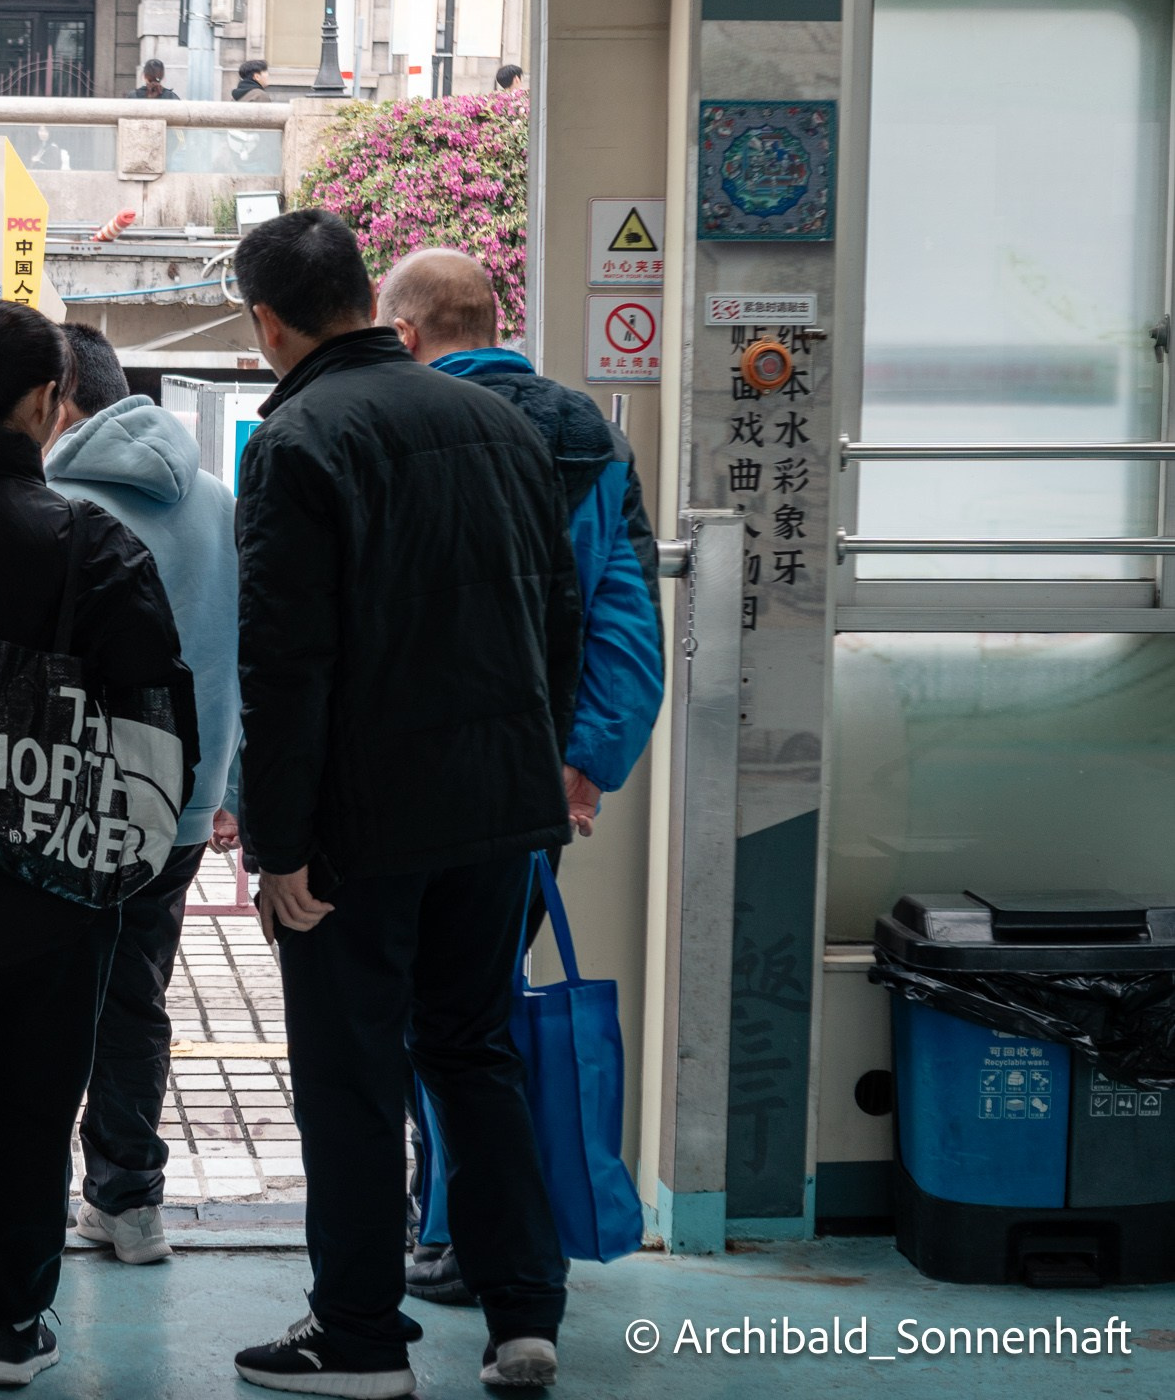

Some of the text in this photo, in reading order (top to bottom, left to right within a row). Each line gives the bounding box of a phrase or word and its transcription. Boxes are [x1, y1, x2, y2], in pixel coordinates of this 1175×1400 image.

[7, 217, 41, 231] PICC
[602, 260, 664, 273] 小心夹手
[23, 798, 130, 874] FACE
[989, 1046, 1042, 1058] 可回收物
[984, 1058, 1026, 1068] Recyclable
